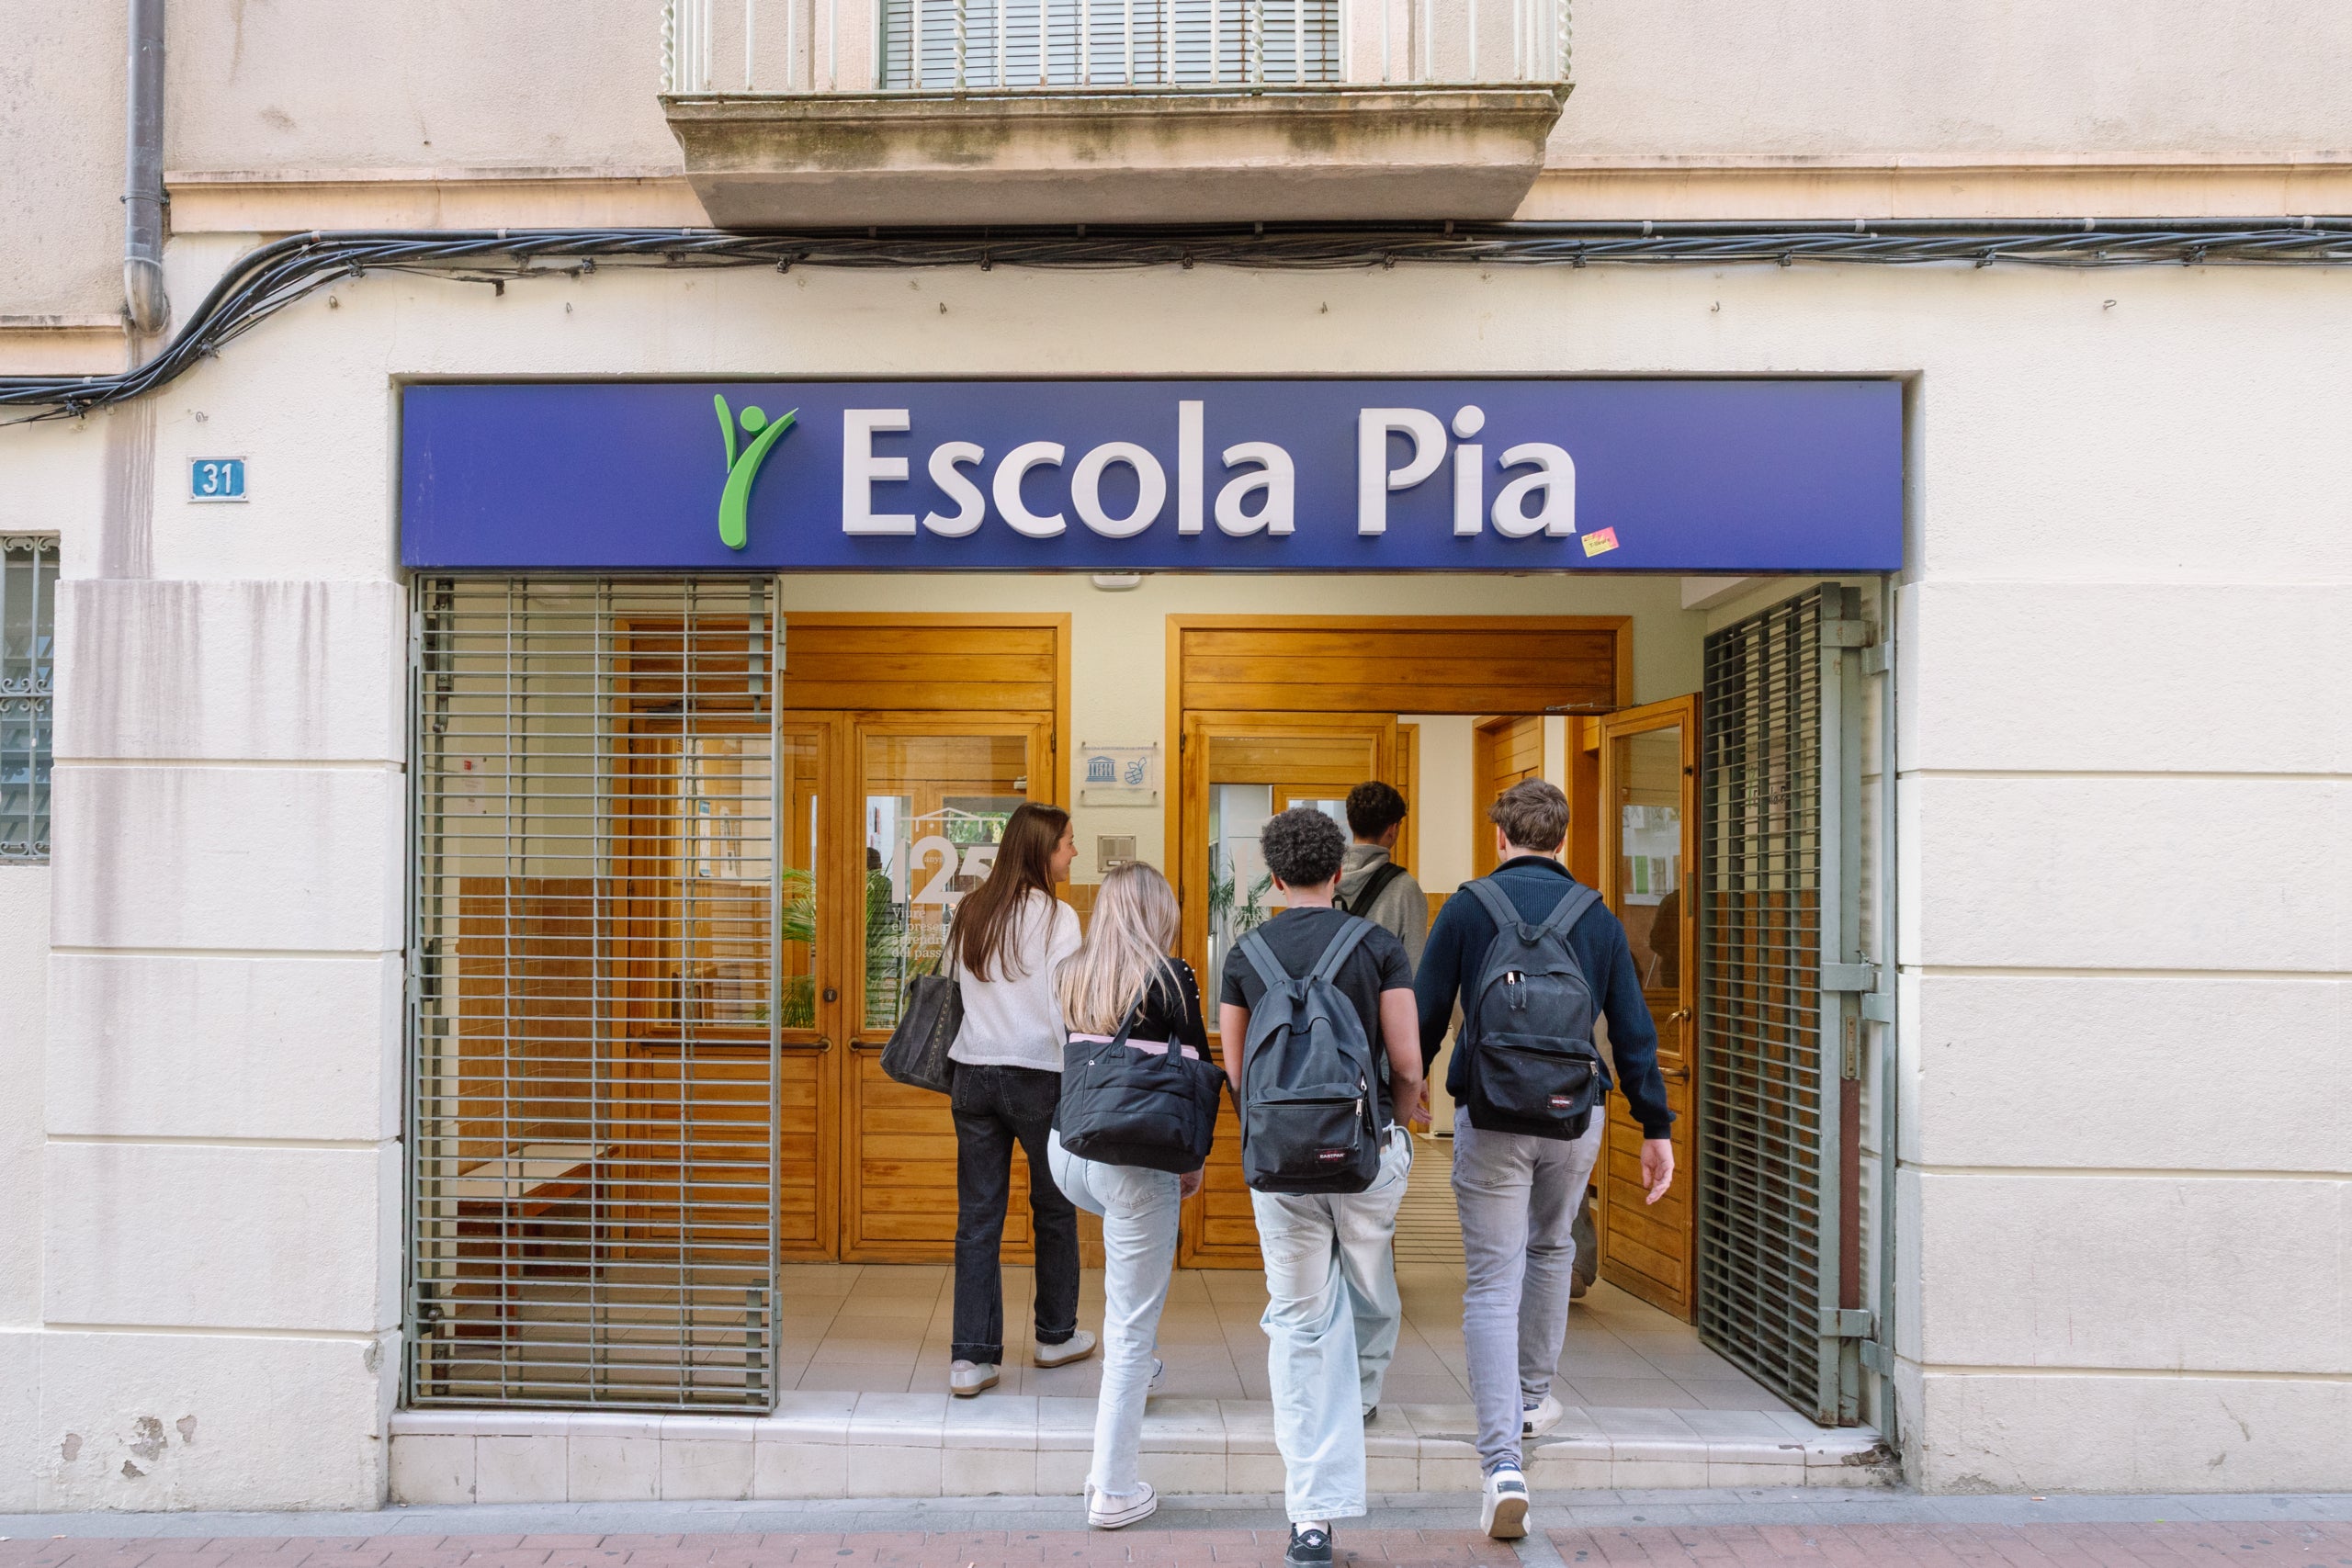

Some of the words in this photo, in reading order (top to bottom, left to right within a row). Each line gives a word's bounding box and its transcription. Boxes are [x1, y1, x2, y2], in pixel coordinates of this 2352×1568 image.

[842, 400, 1295, 538] Escola
[1358, 404, 1577, 538] Pia
[202, 463, 232, 494] 31
[891, 907, 926, 919] Viure
[891, 920, 902, 931] el
[913, 949, 943, 961] pass
